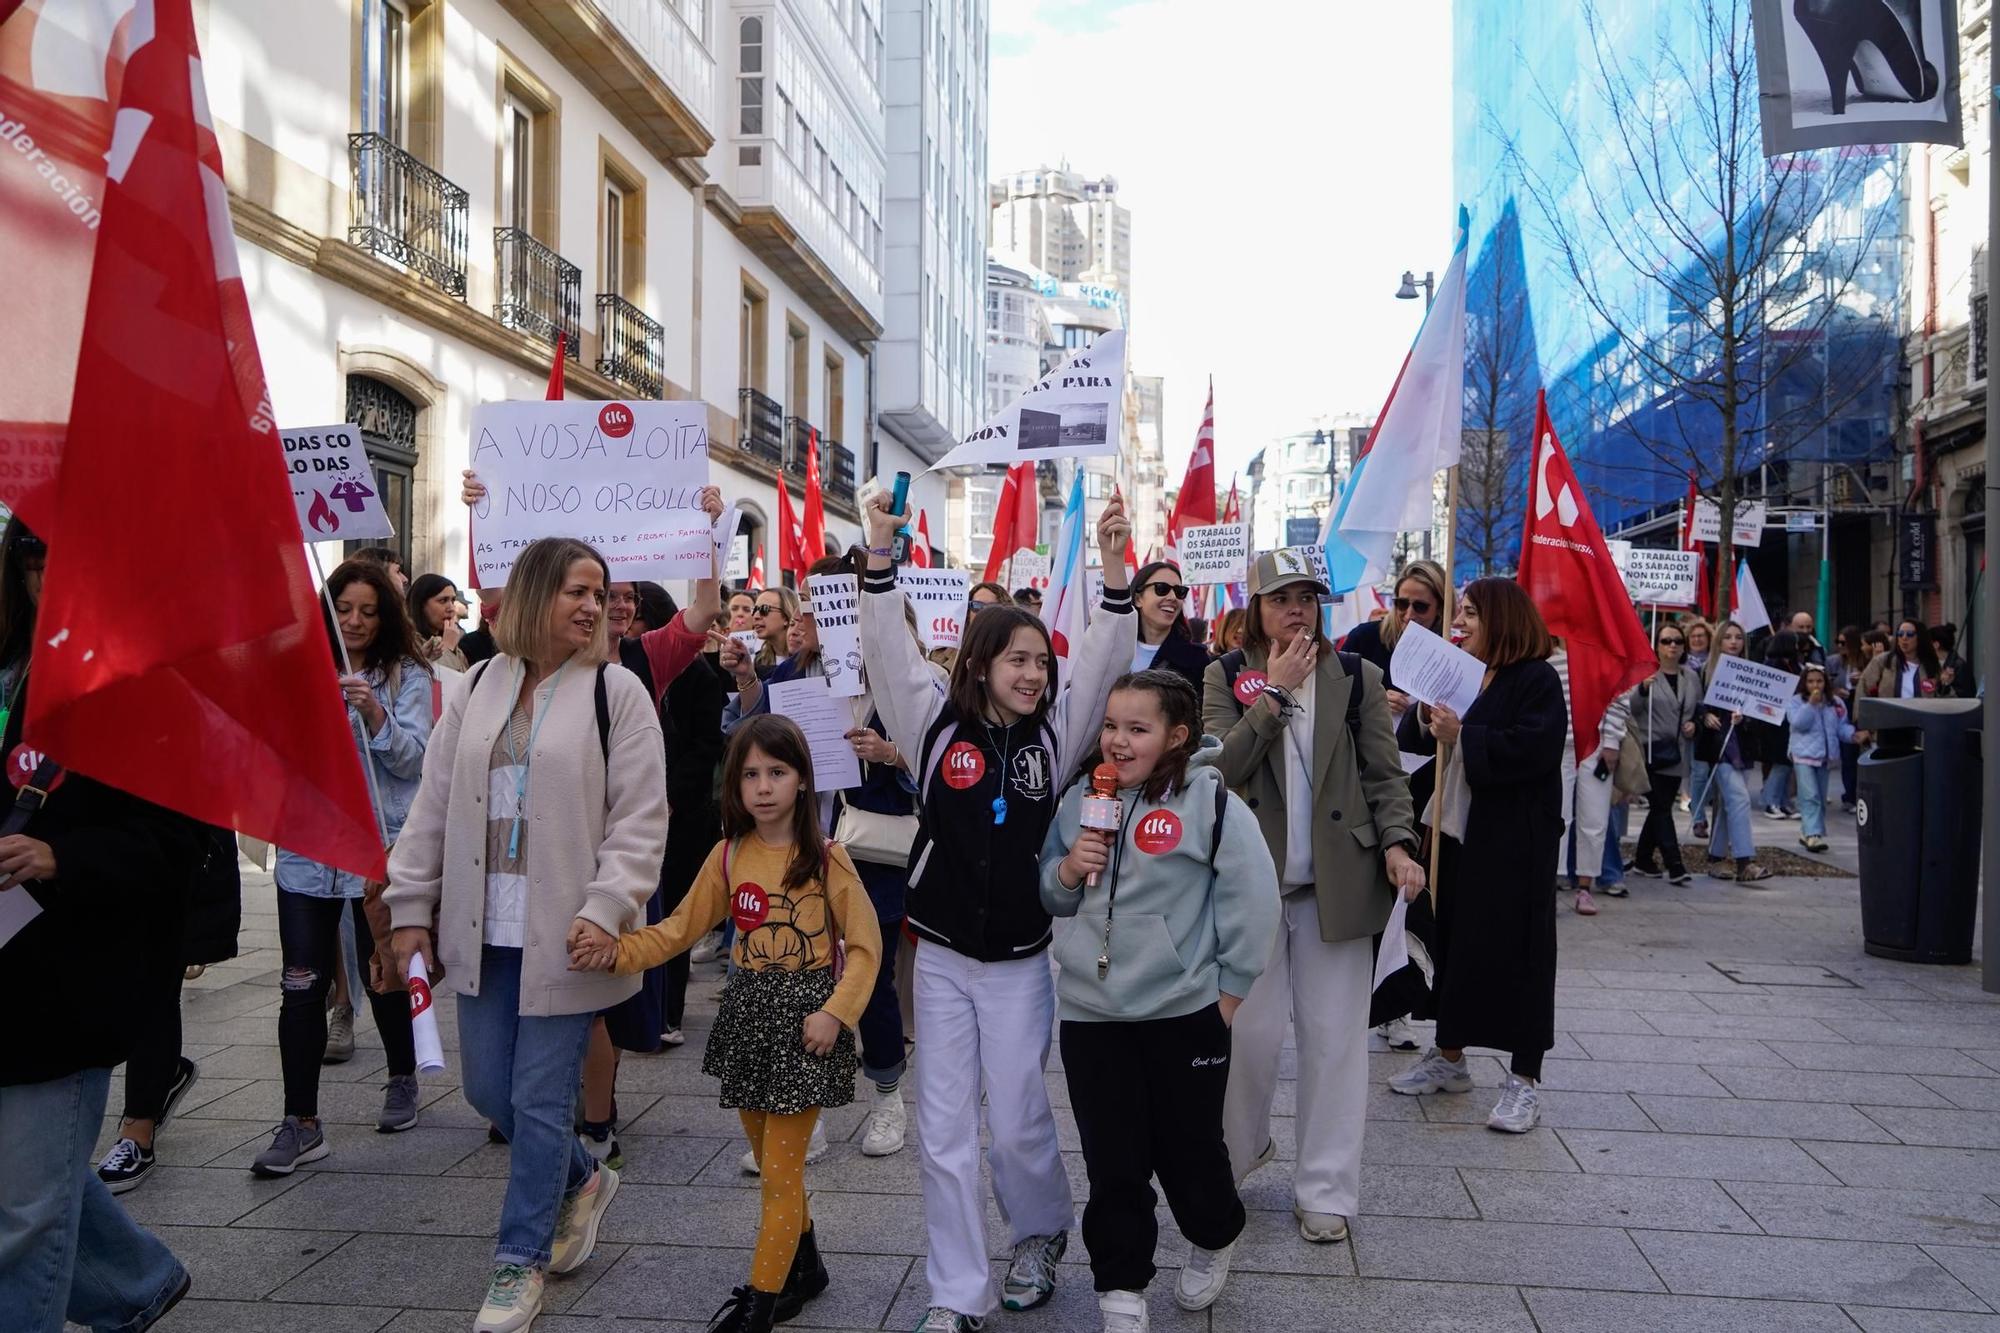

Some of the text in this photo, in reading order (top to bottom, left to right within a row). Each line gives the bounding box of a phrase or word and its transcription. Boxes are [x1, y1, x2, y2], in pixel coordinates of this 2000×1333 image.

[0, 111, 101, 230] deración
[1062, 376, 1113, 388] PARA
[605, 410, 627, 424] CIG
[282, 434, 351, 451] DAS CO
[474, 427, 503, 462] A
[515, 423, 606, 460] VOSA
[959, 425, 1010, 445] BÓN
[312, 456, 350, 471] DAS
[505, 482, 582, 516] NOSO
[1188, 526, 1242, 538] O TRABALLO
[476, 543, 493, 555] AS
[583, 535, 606, 544] RAS
[612, 534, 628, 543] DE
[1187, 537, 1242, 549] OS SÁBADOS
[604, 554, 648, 563] PENDENTAS
[1182, 550, 1202, 560] NON
[1226, 548, 1245, 558] BEN
[1631, 552, 1690, 562] O TRABALLO
[1194, 560, 1231, 570] PAGADO
[1631, 561, 1643, 570] OS
[1626, 571, 1648, 579] NON
[1674, 573, 1694, 582] BEN
[1639, 581, 1678, 591] PAGADO
[917, 592, 964, 601] LOITA!!!
[932, 617, 960, 635] CIG
[1726, 660, 1787, 684] TODOS SOMOS
[1240, 677, 1266, 694] CIG
[1735, 674, 1770, 689] INDITEX
[1714, 693, 1745, 707] TAMÉN
[950, 751, 976, 769] CIG
[1143, 818, 1173, 835] CIG
[738, 891, 761, 912] CIG
